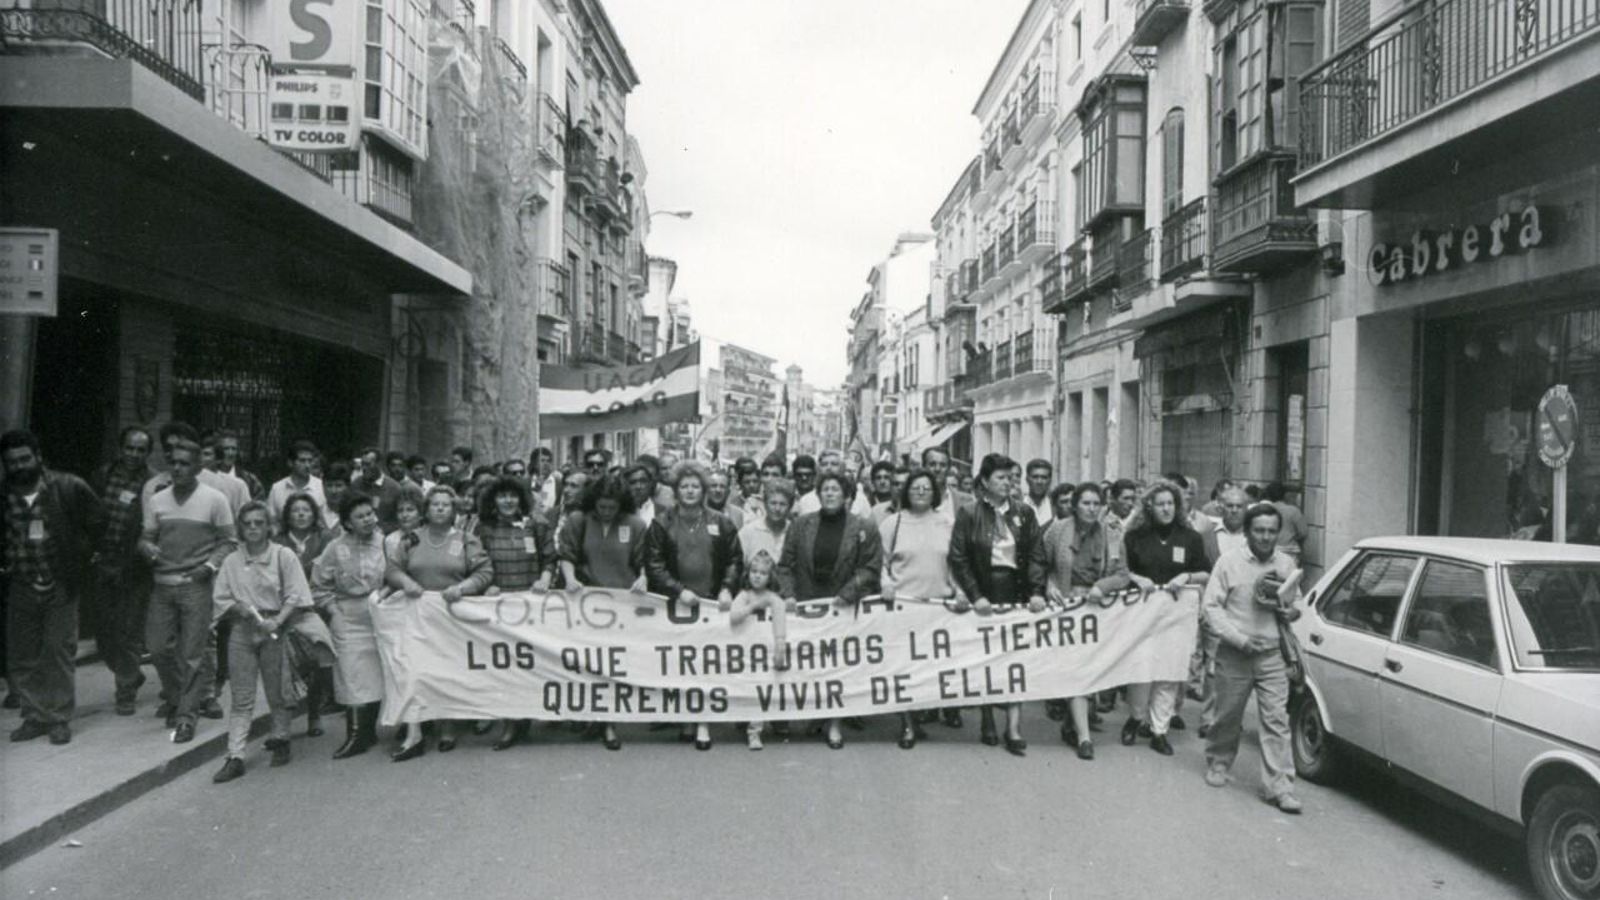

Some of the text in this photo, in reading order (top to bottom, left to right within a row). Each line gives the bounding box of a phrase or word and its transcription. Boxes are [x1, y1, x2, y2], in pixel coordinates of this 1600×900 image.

[276, 81, 318, 94] PHILIPS
[274, 129, 346, 144] TV COLOR
[1367, 205, 1543, 285] Cabrera
[584, 361, 667, 394] UAGA
[466, 613, 1099, 678] LOS QUE TRABAJAMOS LA TIERRA
[543, 663, 1027, 715] QUEREMOS VIVIR DE ELLA
